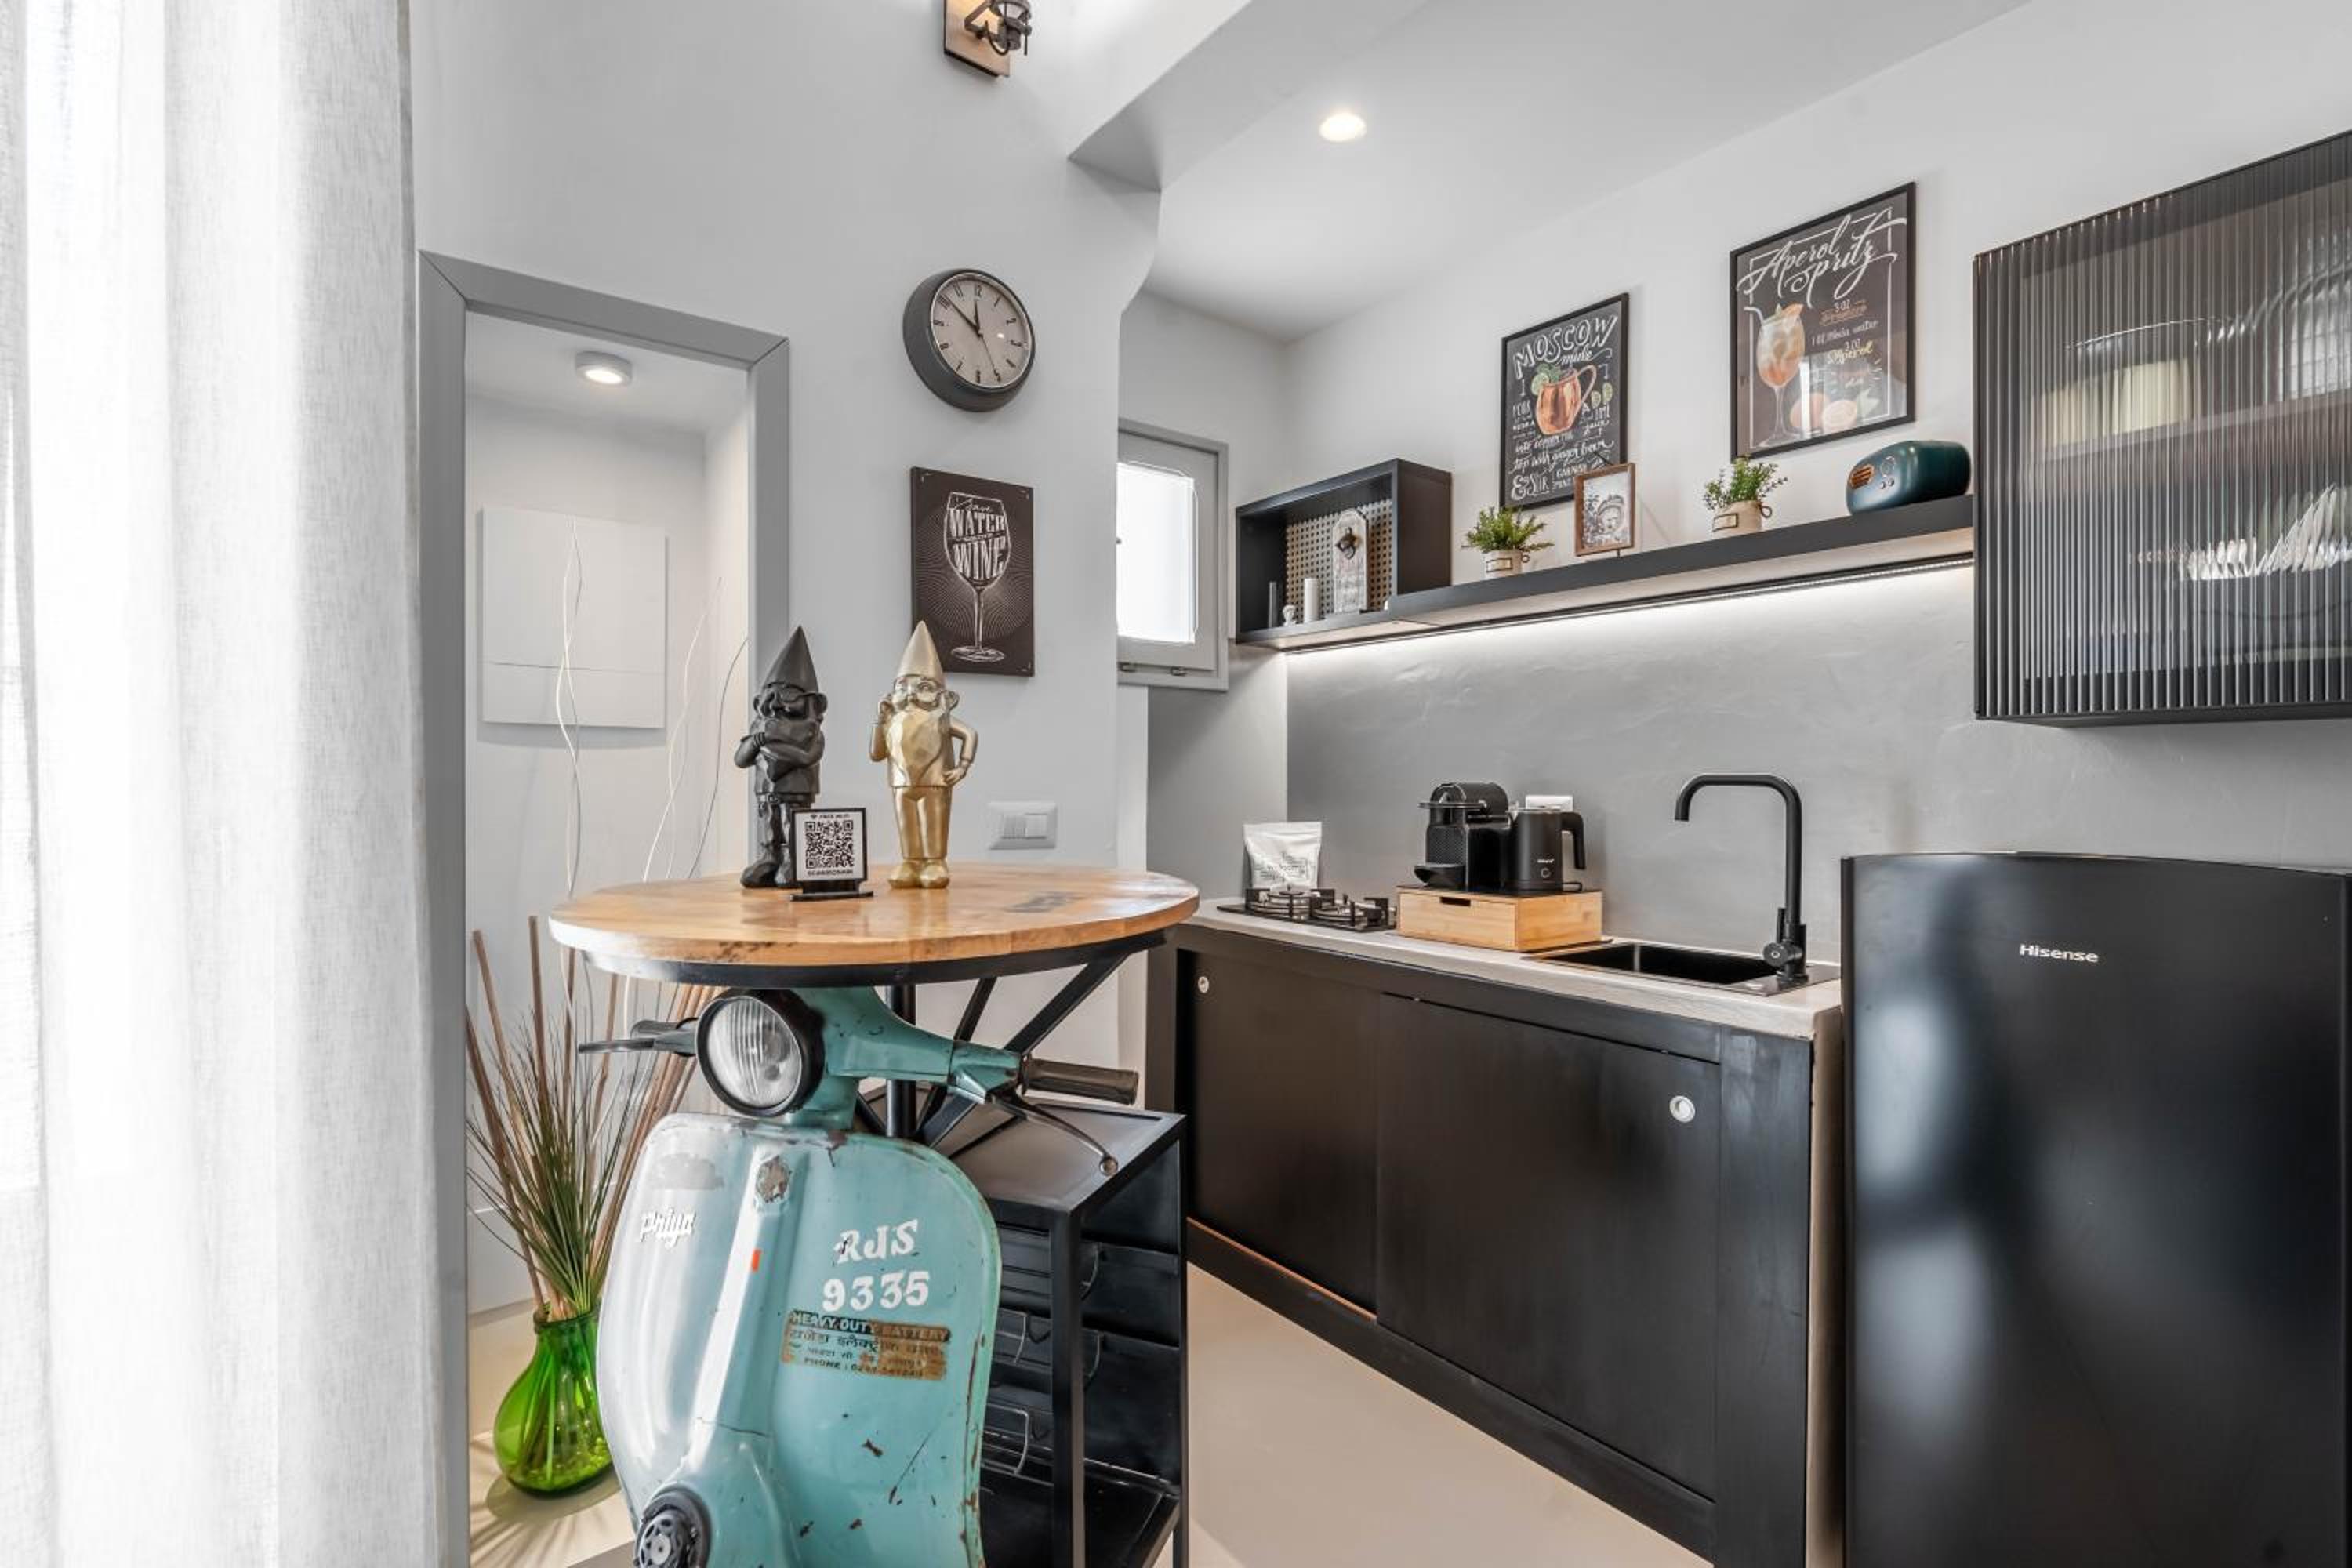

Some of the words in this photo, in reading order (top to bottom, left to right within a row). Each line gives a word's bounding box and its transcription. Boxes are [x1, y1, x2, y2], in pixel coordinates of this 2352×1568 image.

[1736, 213, 1852, 299] Aperol
[1513, 315, 1618, 379] MOSCOW
[949, 507, 1005, 537] WATER
[953, 536, 1006, 579] WINE
[2020, 944, 2099, 963] Hisense
[833, 1218, 919, 1265] RJS
[822, 1269, 931, 1312] 9335
[791, 1312, 836, 1330] HEAVY
